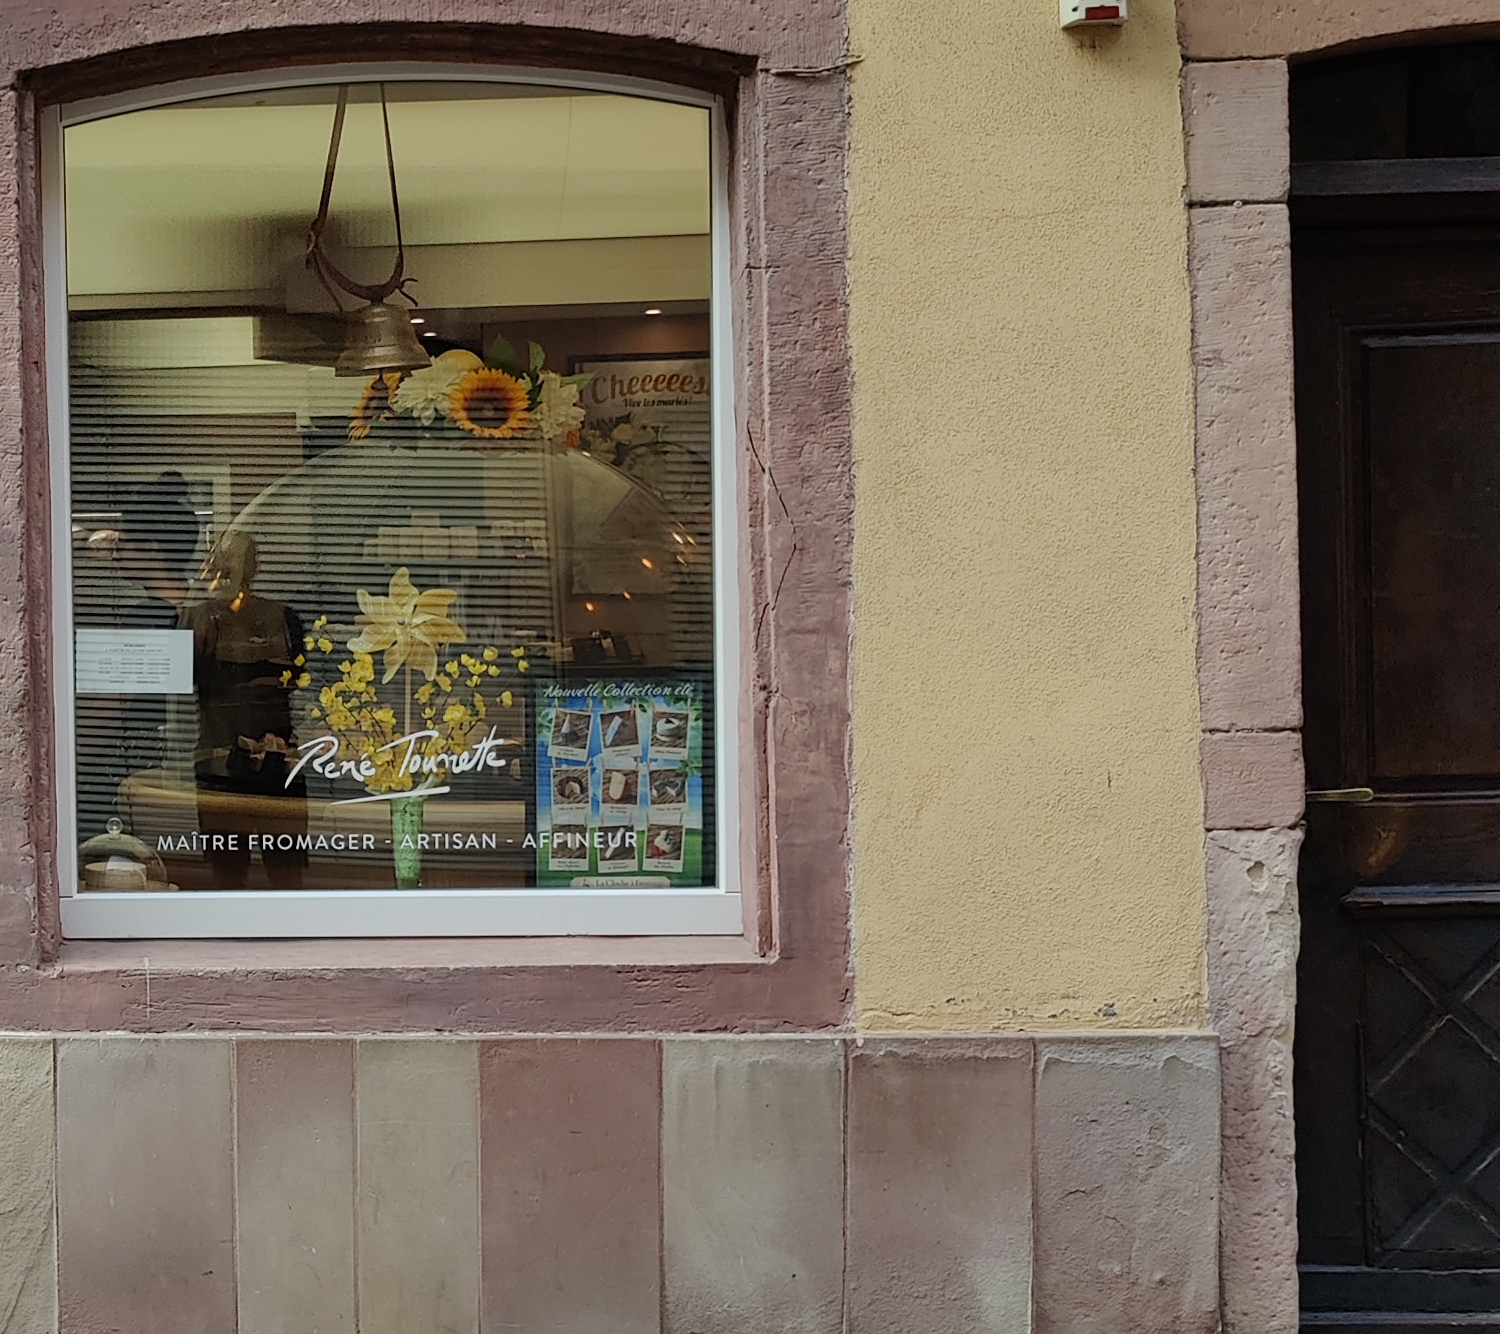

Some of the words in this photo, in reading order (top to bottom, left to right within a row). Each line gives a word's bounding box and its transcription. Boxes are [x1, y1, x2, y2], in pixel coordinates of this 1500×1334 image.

[543, 682, 599, 698] Nouvelle
[603, 682, 671, 697] Collection
[674, 681, 694, 696] été
[284, 735, 376, 789] René
[157, 830, 239, 852] MAÎTRE
[248, 833, 376, 851] FROMAGER
[399, 832, 497, 850] ARTISAN
[521, 830, 638, 849] AFFINEUR
